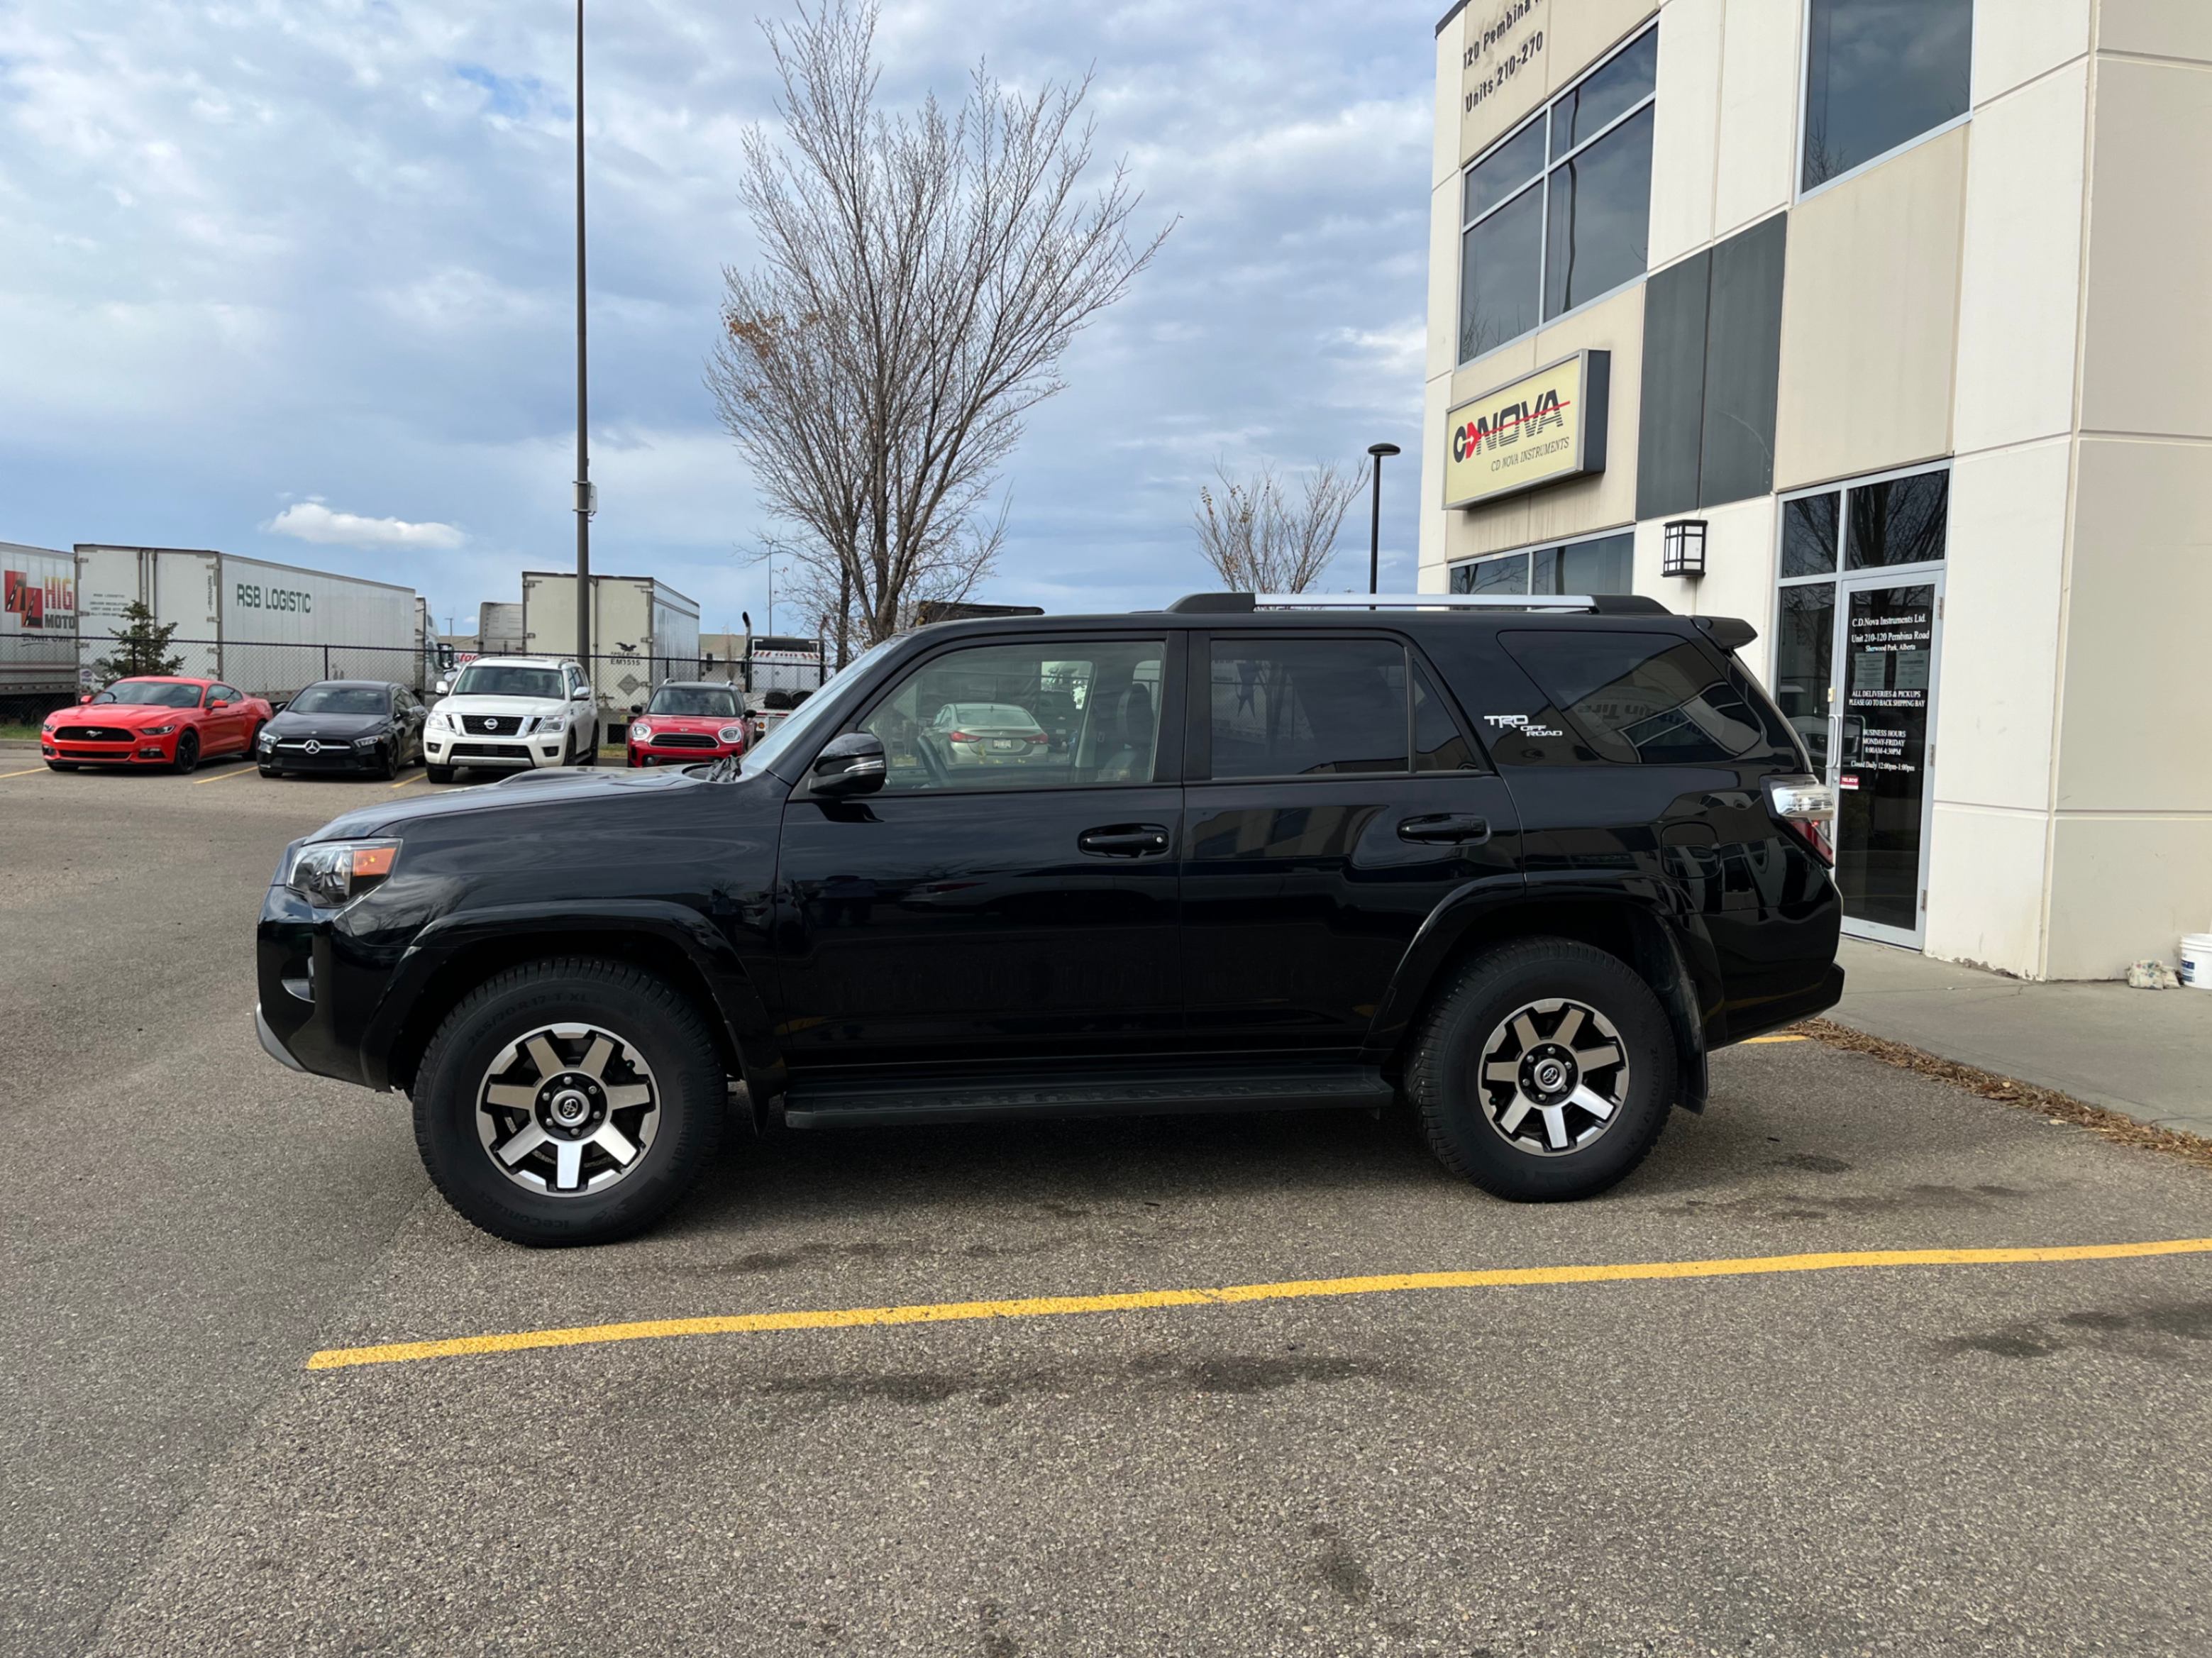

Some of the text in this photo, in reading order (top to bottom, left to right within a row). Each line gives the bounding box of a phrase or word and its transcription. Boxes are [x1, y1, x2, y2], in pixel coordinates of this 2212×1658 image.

[1464, 0, 1530, 70] 120 Pembina
[1466, 31, 1543, 112] Units 210-270
[1491, 436, 1570, 472] CD NOVA INSTRUMENTS
[236, 583, 261, 608] RSB
[265, 587, 311, 614] LOGISTIC
[1880, 616, 1913, 625] Instruments
[1851, 629, 1930, 643] Unit 210-120 Pembina Road
[1483, 714, 1529, 729] TRD
[1862, 738, 1906, 747] MONDAY-FRIDAY
[1866, 761, 1877, 770] Daily
